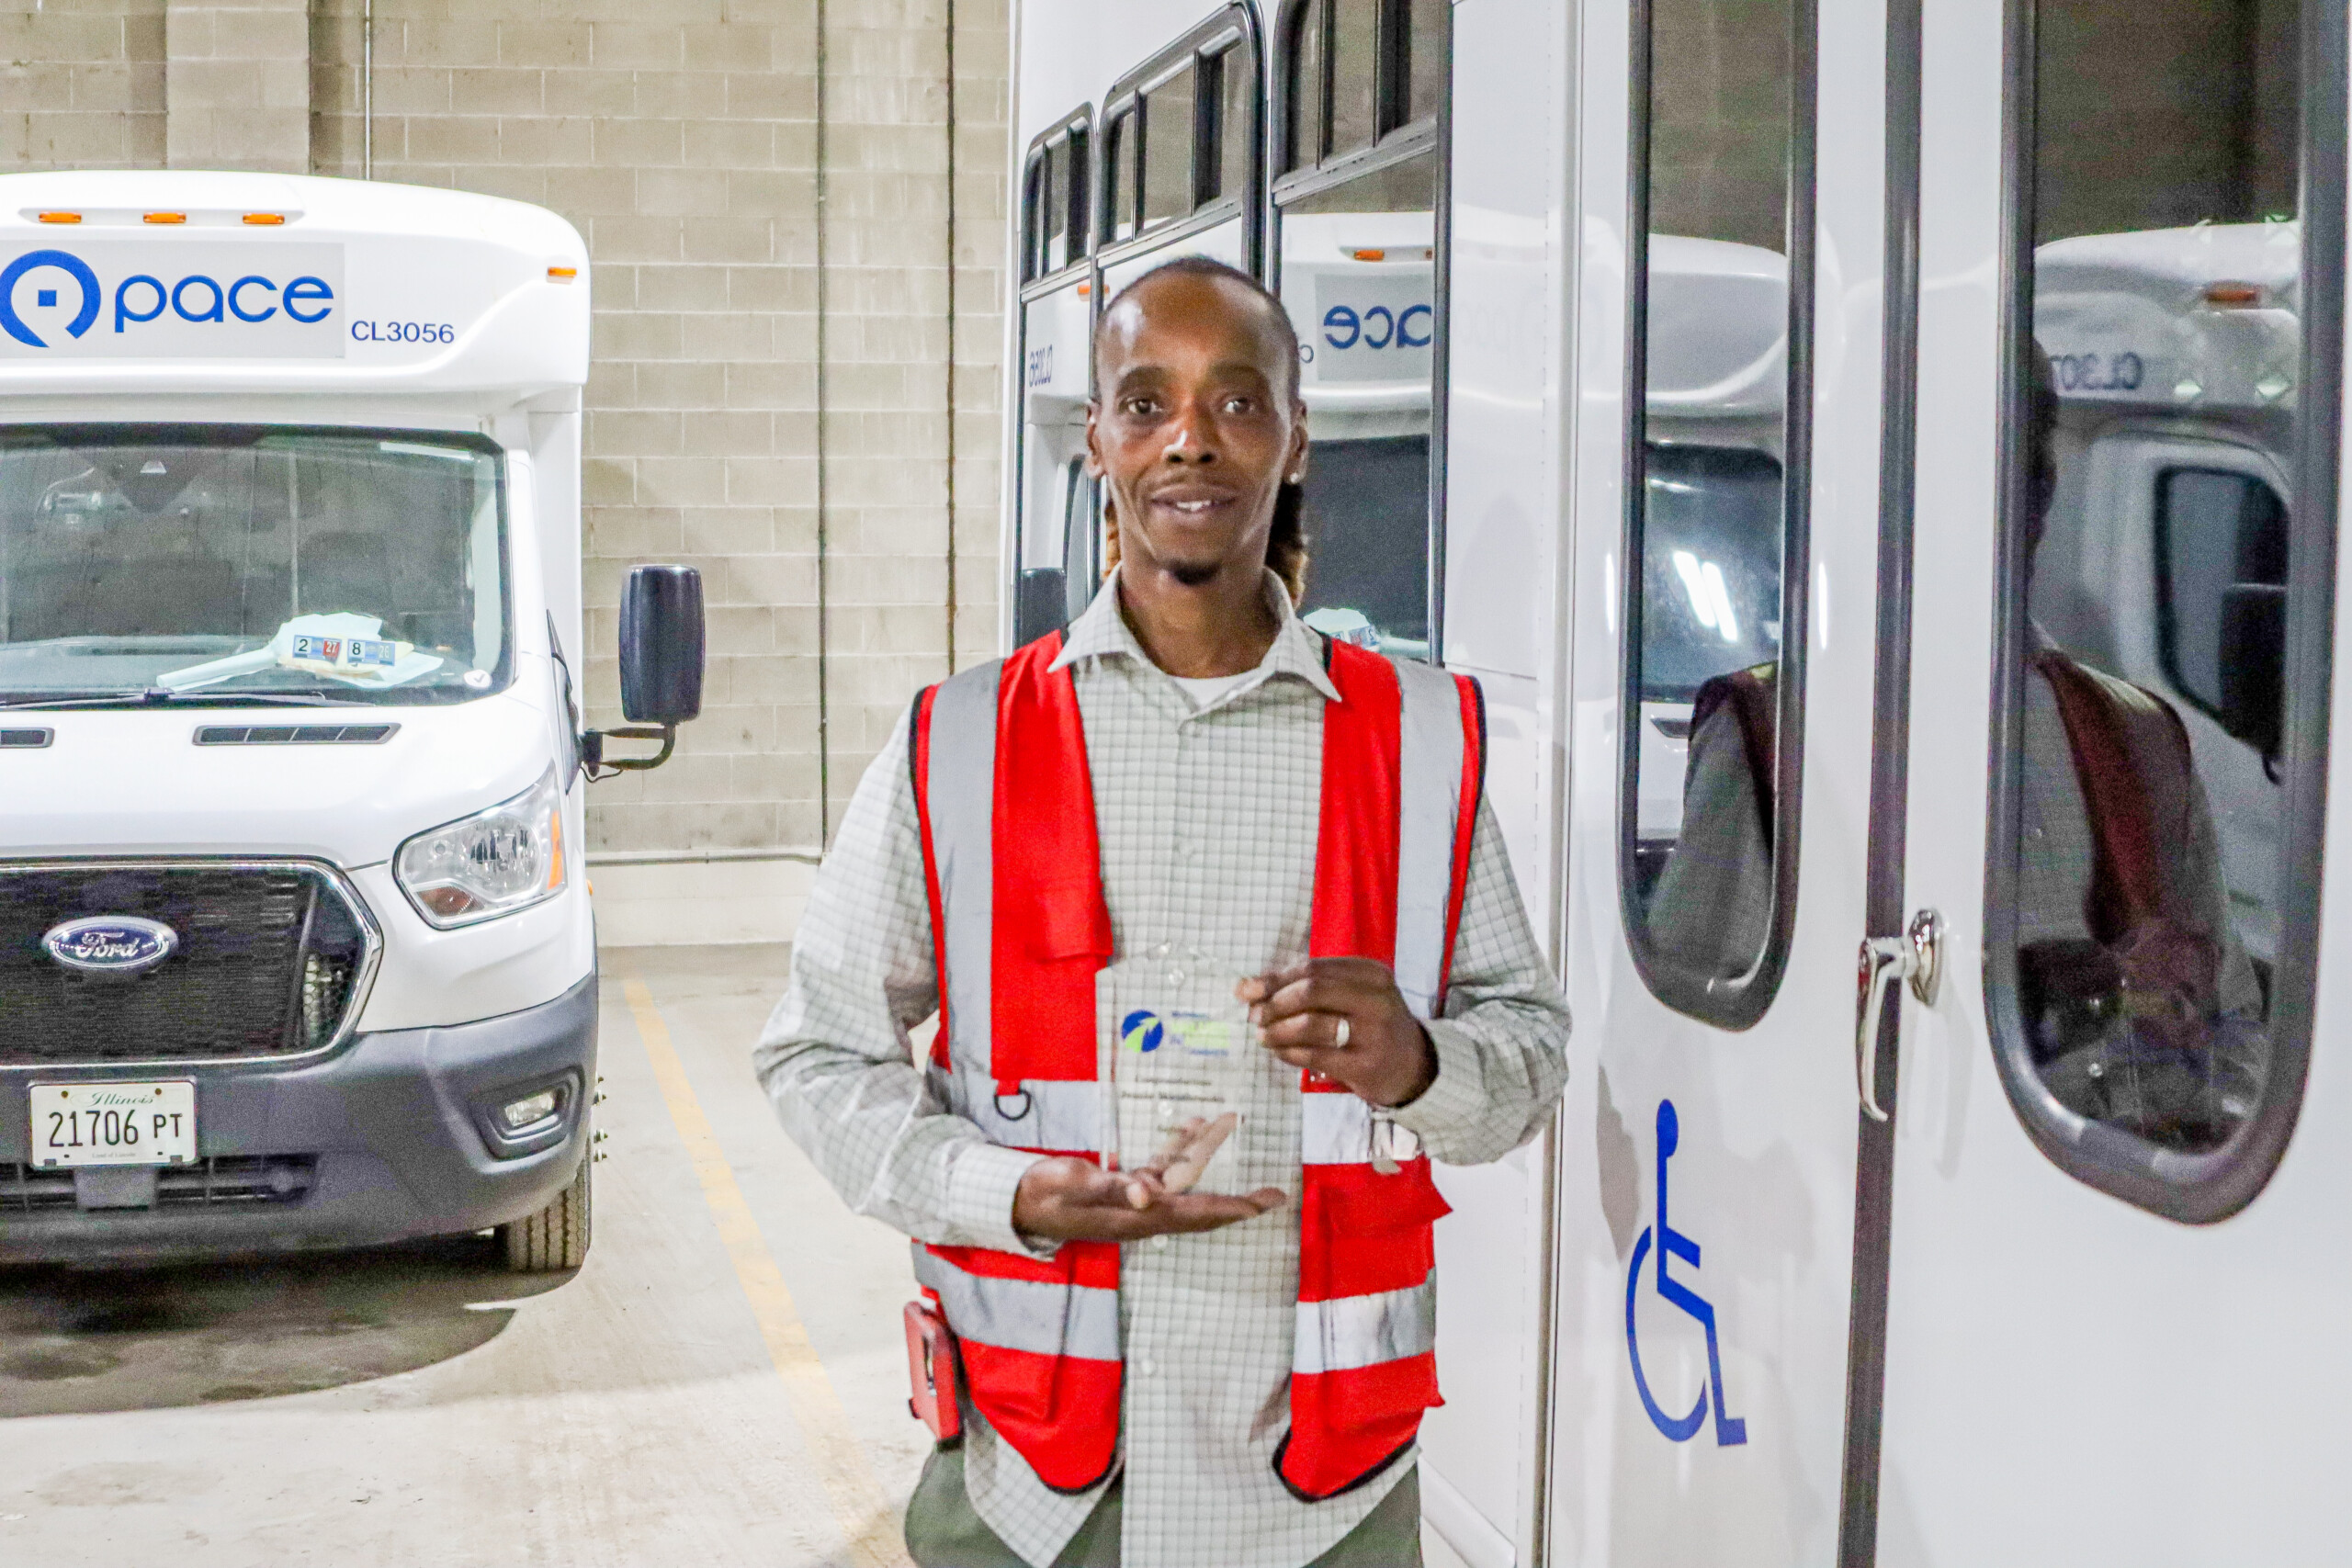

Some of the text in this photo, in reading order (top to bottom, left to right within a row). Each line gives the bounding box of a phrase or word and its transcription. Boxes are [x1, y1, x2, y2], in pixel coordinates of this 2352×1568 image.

[115, 275, 334, 333] pace
[351, 320, 455, 344] CL3056
[298, 638, 338, 654] 2 27
[352, 642, 362, 655] 8
[75, 932, 139, 957] Ford
[89, 1090, 154, 1106] Illinois
[49, 1109, 183, 1146] 21706 PT
